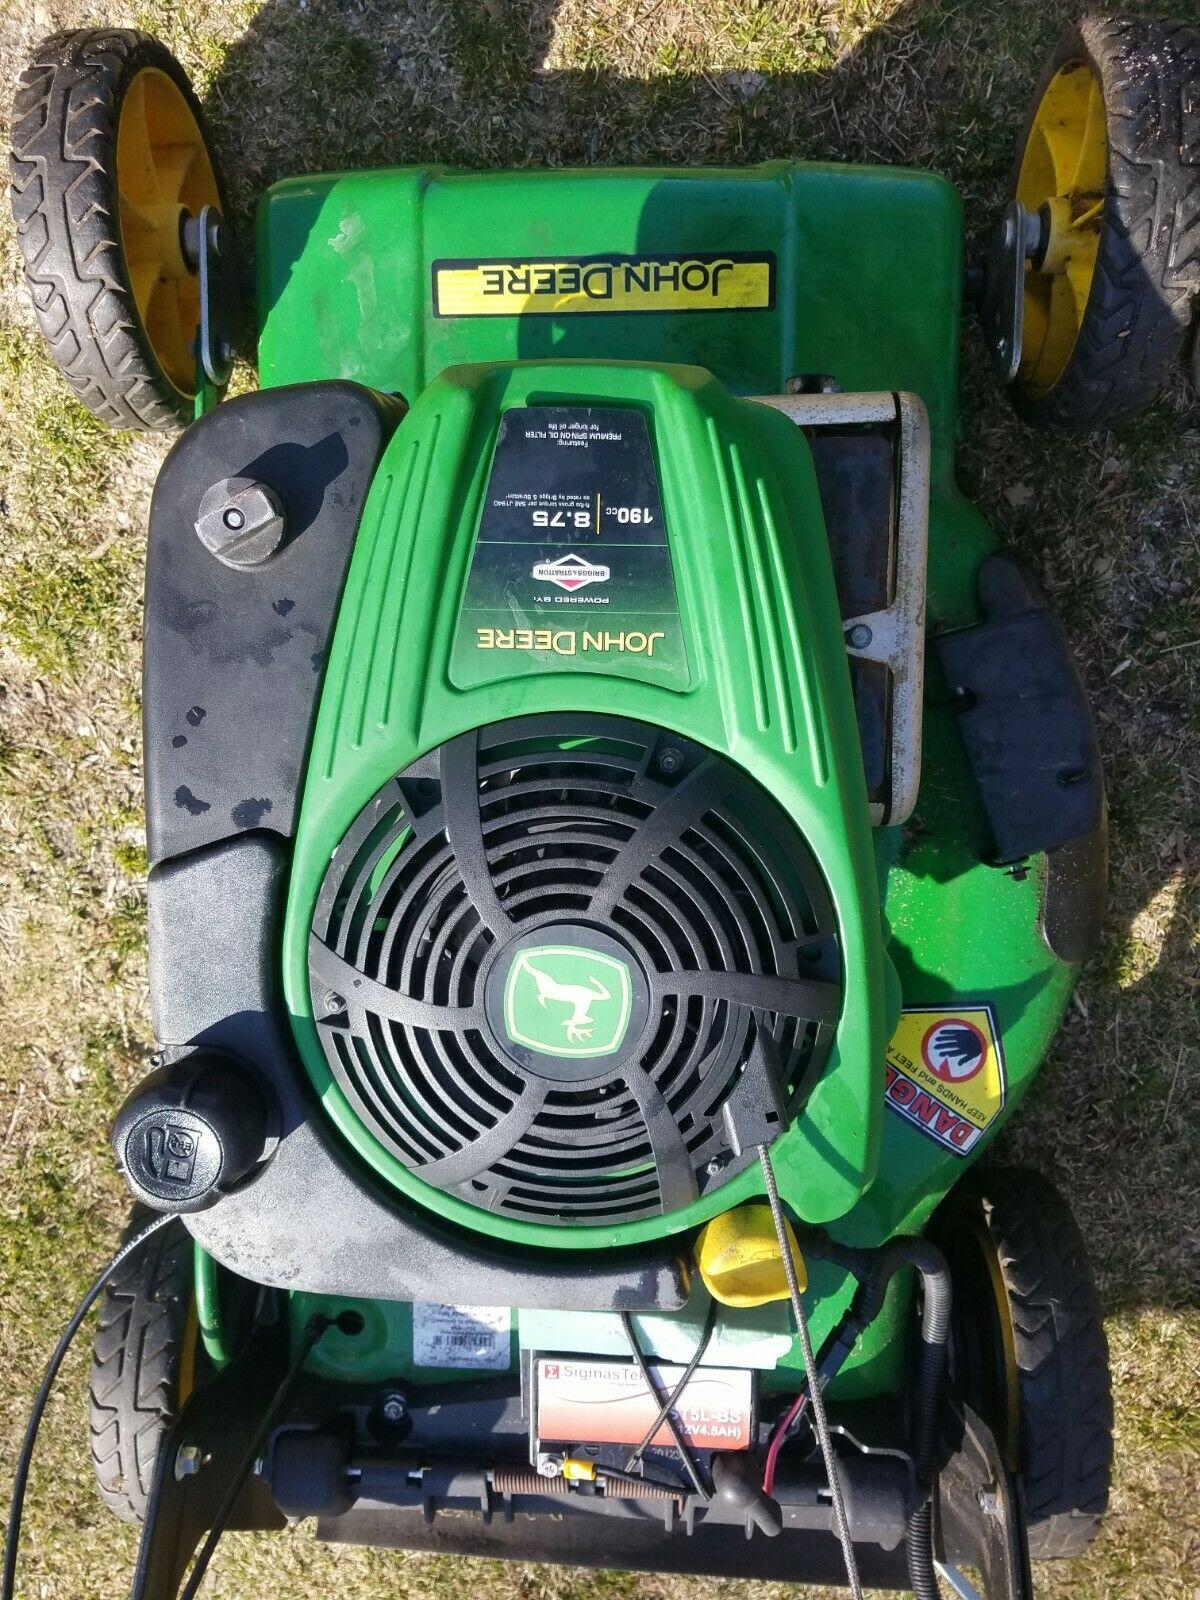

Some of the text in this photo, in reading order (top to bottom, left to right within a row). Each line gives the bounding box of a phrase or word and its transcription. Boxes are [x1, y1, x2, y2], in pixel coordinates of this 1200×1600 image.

[482, 264, 733, 299] JOHN DEERE
[568, 423, 588, 431] longer
[589, 432, 621, 440] PREMIUM
[532, 511, 591, 527] 8.75
[554, 596, 610, 604] POWERED
[476, 628, 665, 657] JOHN DEERE
[893, 1052, 918, 1075] FEET
[918, 1070, 936, 1086] and
[937, 1083, 967, 1110] HANDS
[966, 1107, 987, 1122] KEEP
